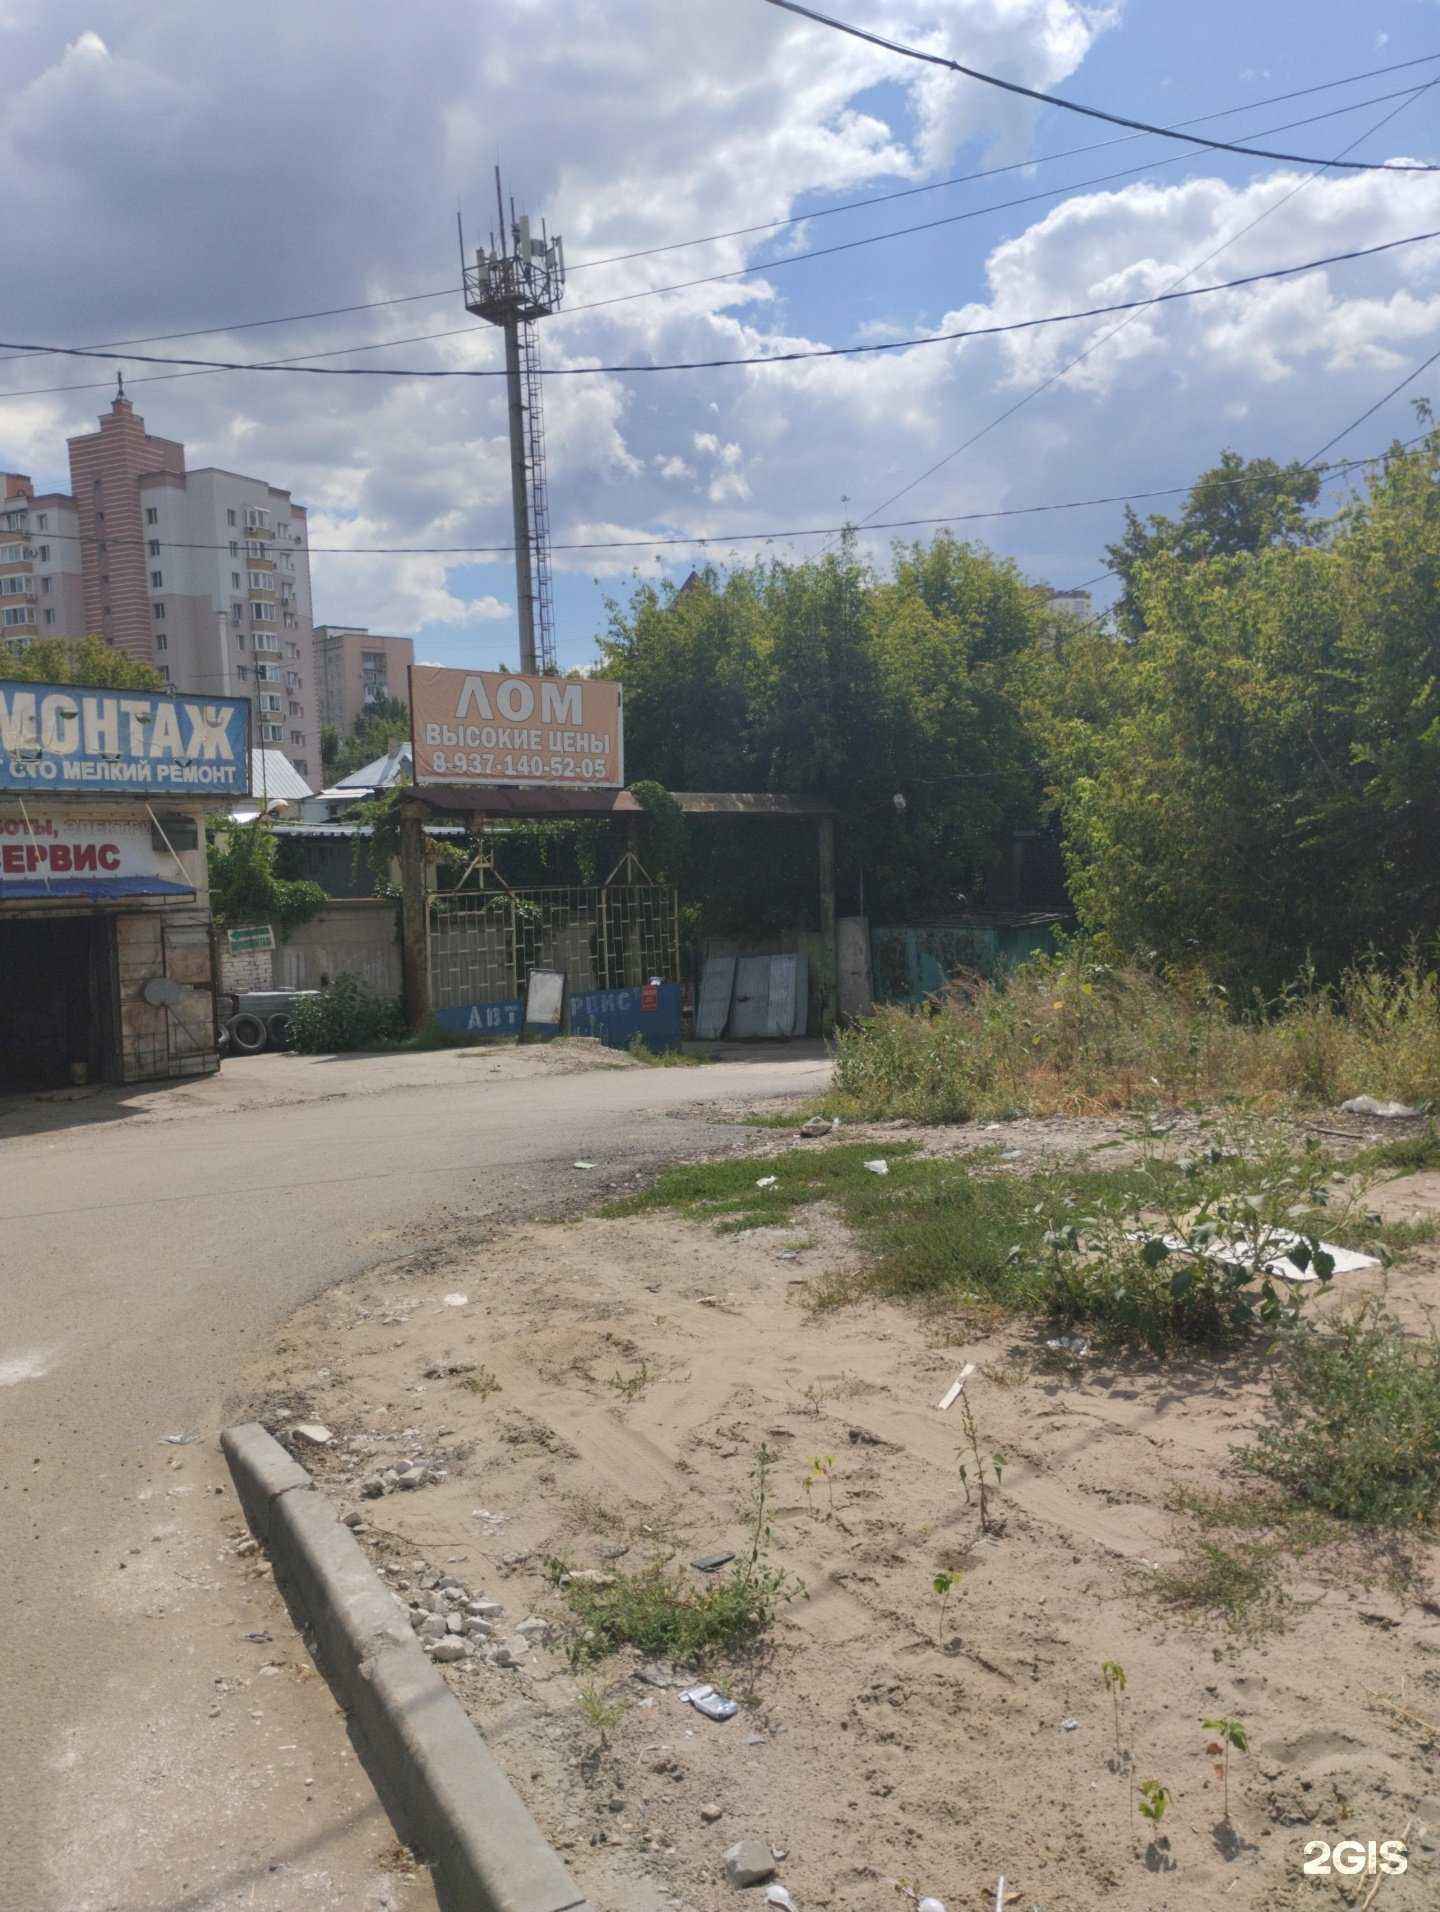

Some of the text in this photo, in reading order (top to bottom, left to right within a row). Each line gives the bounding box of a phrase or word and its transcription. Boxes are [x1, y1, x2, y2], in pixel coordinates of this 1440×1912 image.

[455, 675, 584, 726] ЛОМ
[425, 723, 611, 755] ВЫСОКИЕ ЦЕНЫ
[63, 758, 152, 782] МЕЛКИЙ
[157, 763, 237, 784] РЕМОНТ
[432, 751, 607, 778] 8-937-140-52-05
[0, 843, 121, 874] ЕРВИС
